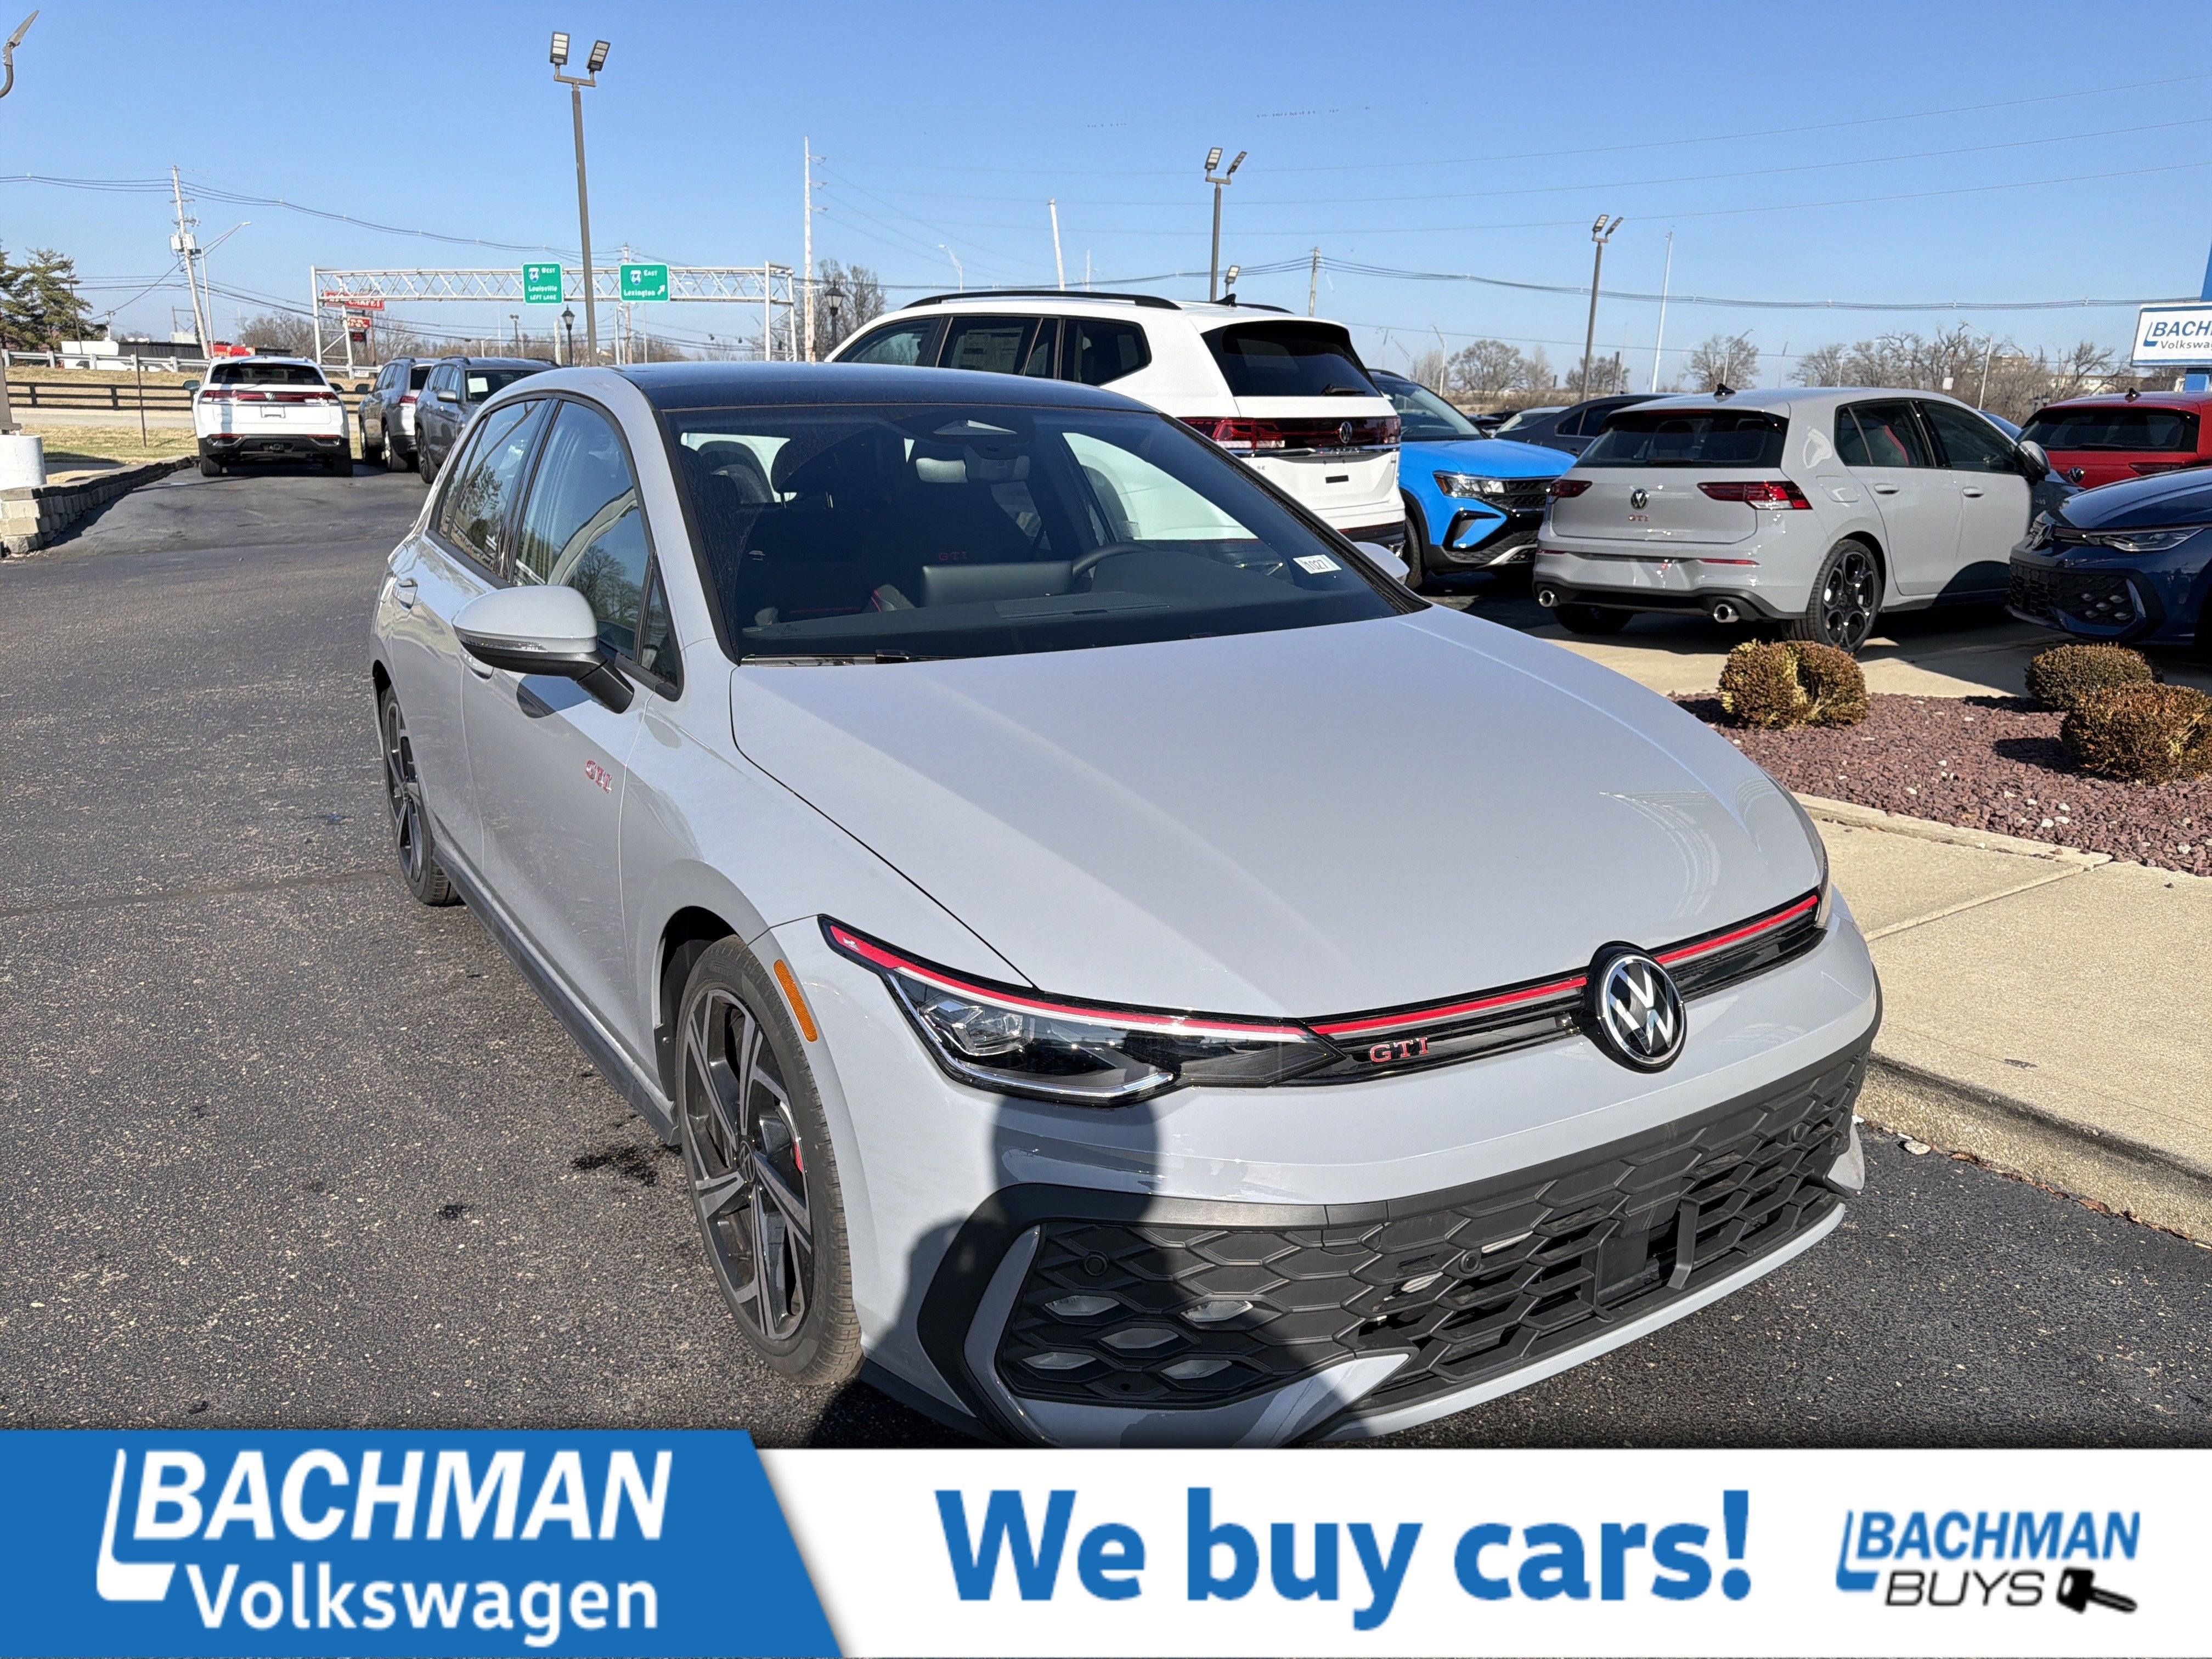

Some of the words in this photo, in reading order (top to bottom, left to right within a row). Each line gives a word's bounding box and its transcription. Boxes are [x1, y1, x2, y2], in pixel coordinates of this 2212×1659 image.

[623, 289, 656, 298] Lexington
[2153, 321, 2212, 336] BACH
[2161, 340, 2212, 351] Volkswa
[1369, 1036, 1430, 1063] GTI
